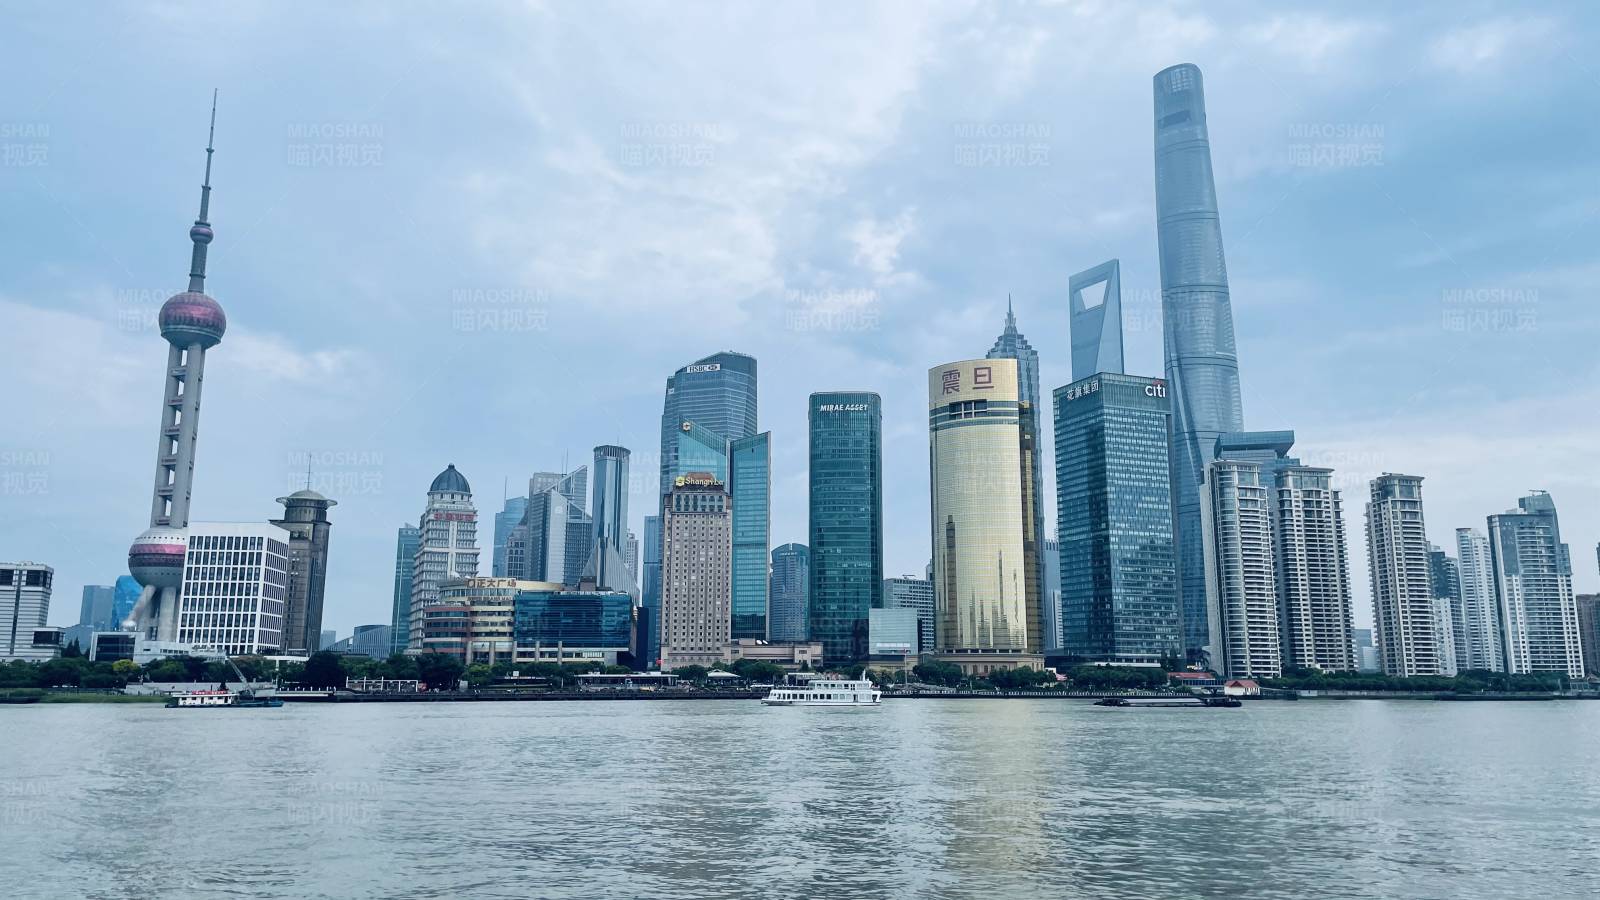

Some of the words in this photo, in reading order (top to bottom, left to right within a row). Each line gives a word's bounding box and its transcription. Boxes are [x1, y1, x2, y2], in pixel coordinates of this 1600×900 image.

[942, 366, 995, 395] 震旦
[1066, 379, 1099, 401] 花旗集团
[1145, 384, 1166, 398] citi
[820, 404, 844, 412] MIRAE
